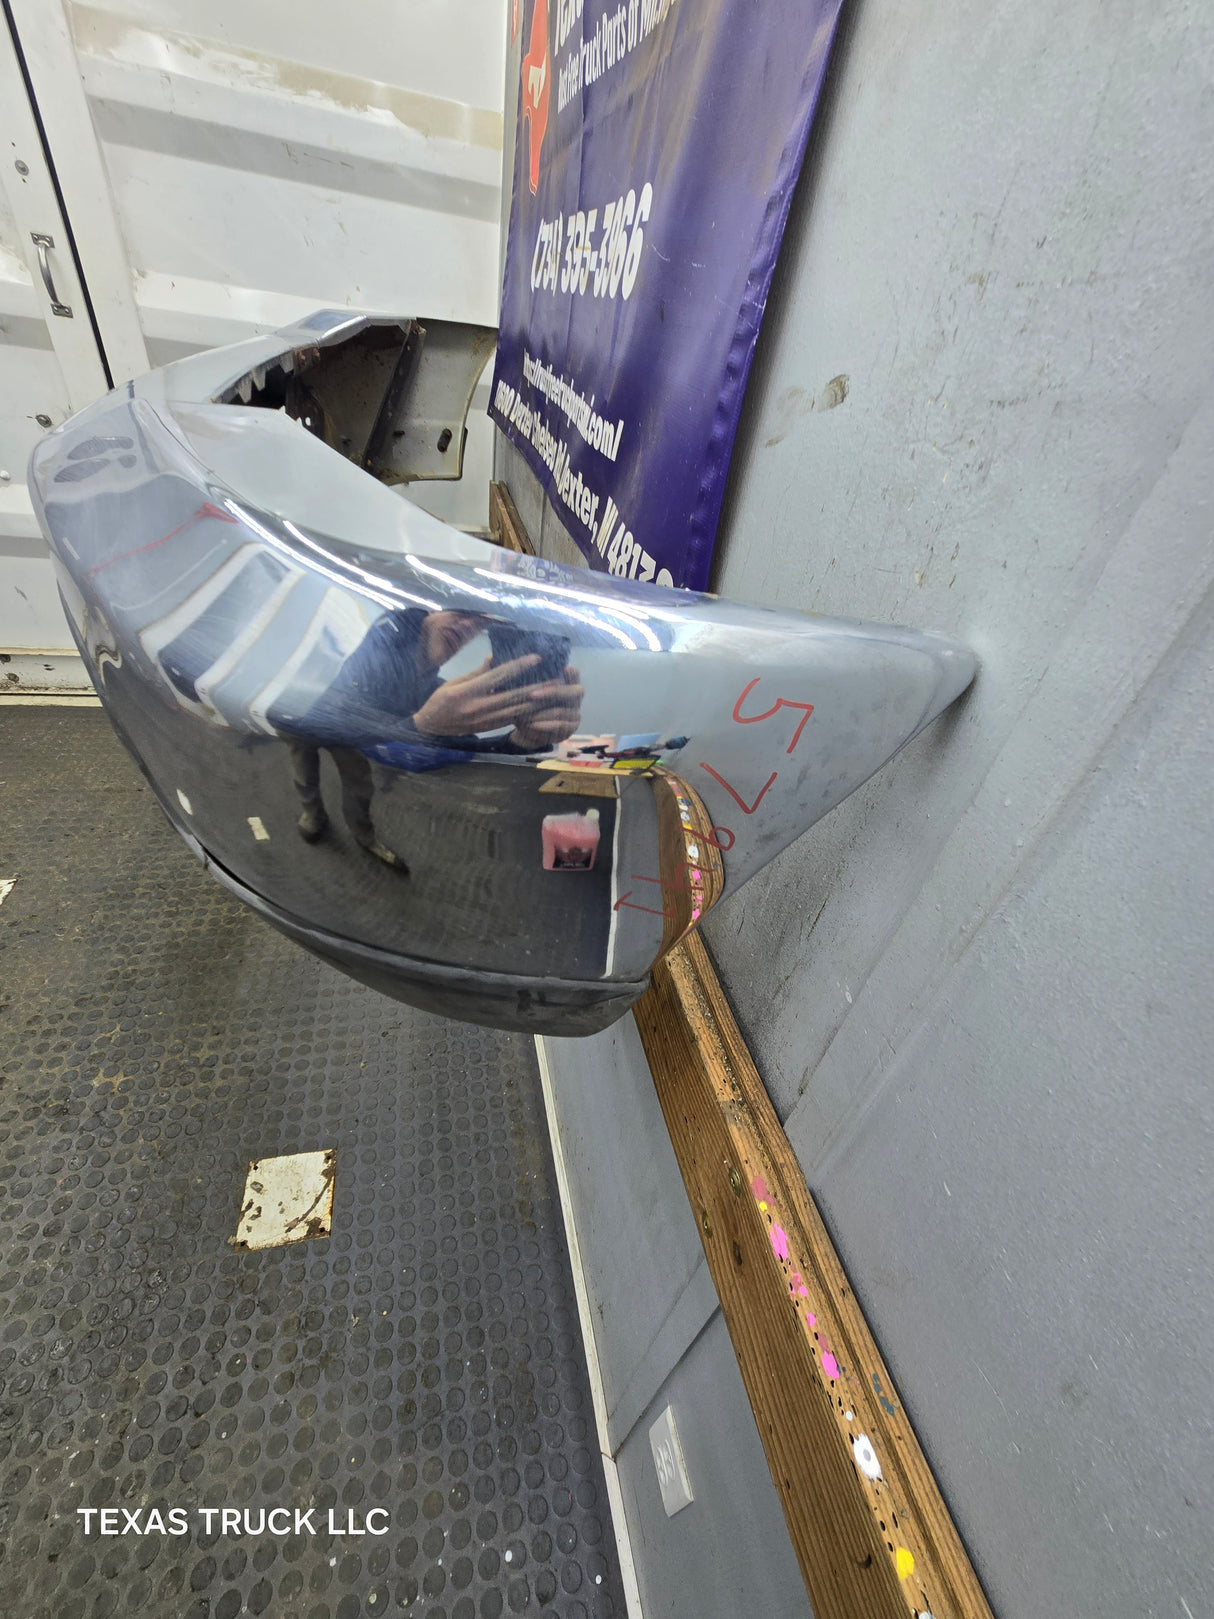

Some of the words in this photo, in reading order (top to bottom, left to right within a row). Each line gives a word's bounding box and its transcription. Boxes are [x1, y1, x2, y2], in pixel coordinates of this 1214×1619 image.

[578, 21, 602, 90] Truck
[602, 3, 627, 73] Parts
[530, 210, 563, 297] (734)
[561, 182, 653, 301] 395-3966
